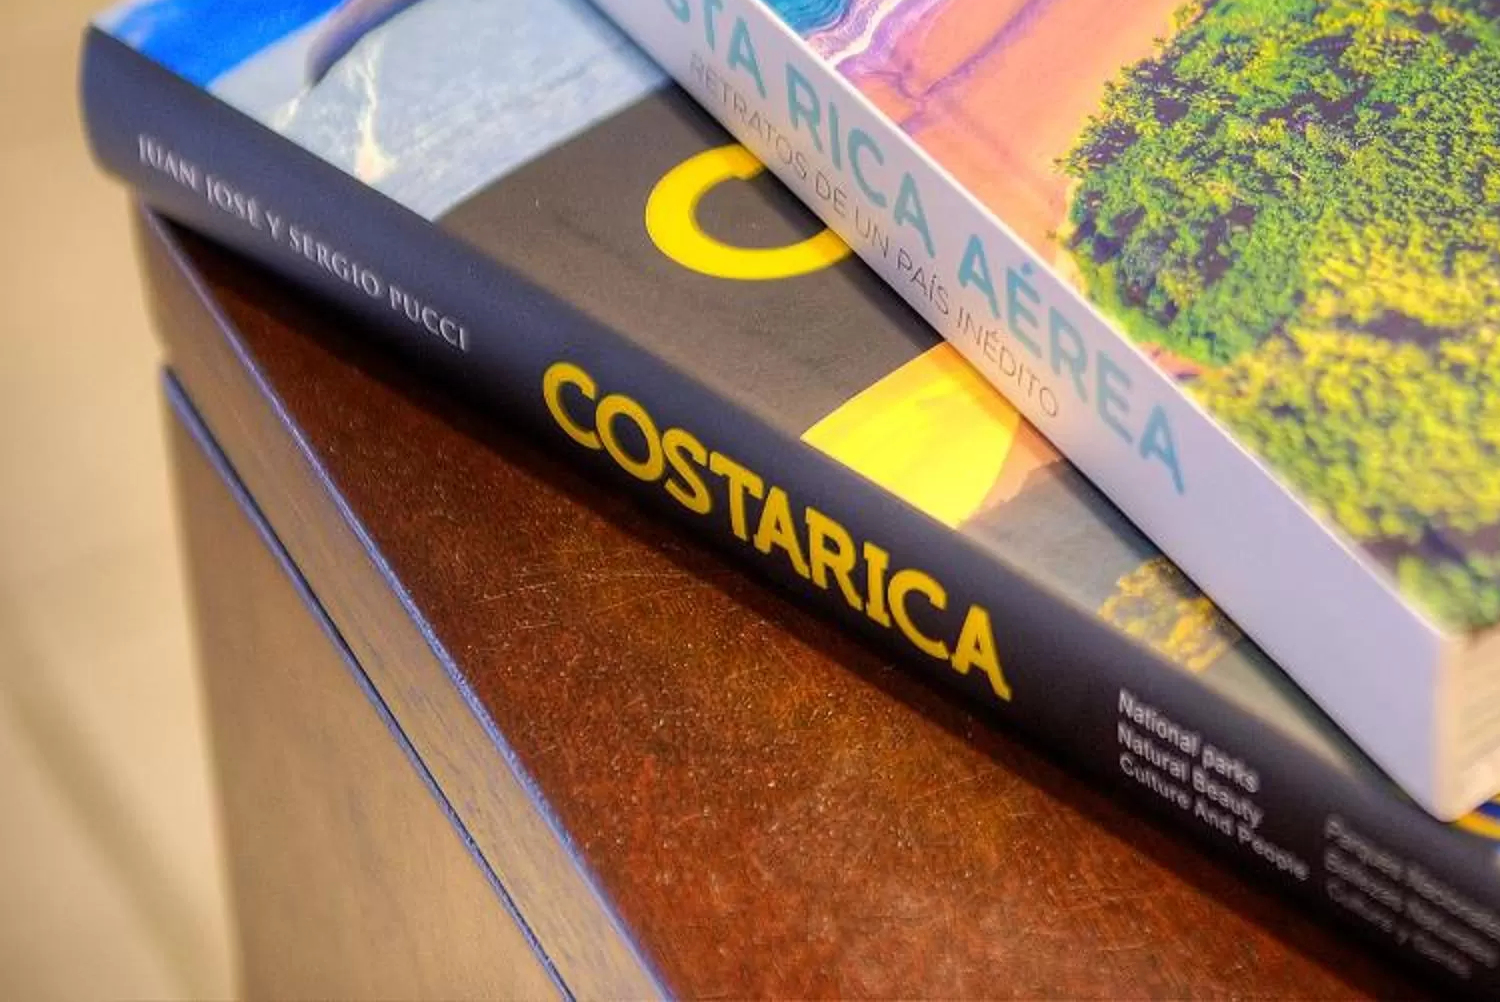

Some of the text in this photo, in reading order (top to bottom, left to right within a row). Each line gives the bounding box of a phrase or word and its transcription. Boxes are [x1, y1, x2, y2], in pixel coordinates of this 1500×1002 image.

[138, 133, 199, 193] JUAN
[288, 221, 382, 298] SERGIO
[388, 284, 470, 353] PUCCI
[689, 52, 1060, 419] RETRATOS DE UN PAÍS INÉDITO
[784, 60, 936, 259] RICA
[957, 232, 1187, 496] AÉREA
[1117, 720, 1265, 829] Natural Beauty
[1118, 687, 1199, 757] National
[1118, 750, 1192, 811] Culture
[1236, 822, 1310, 881] People
